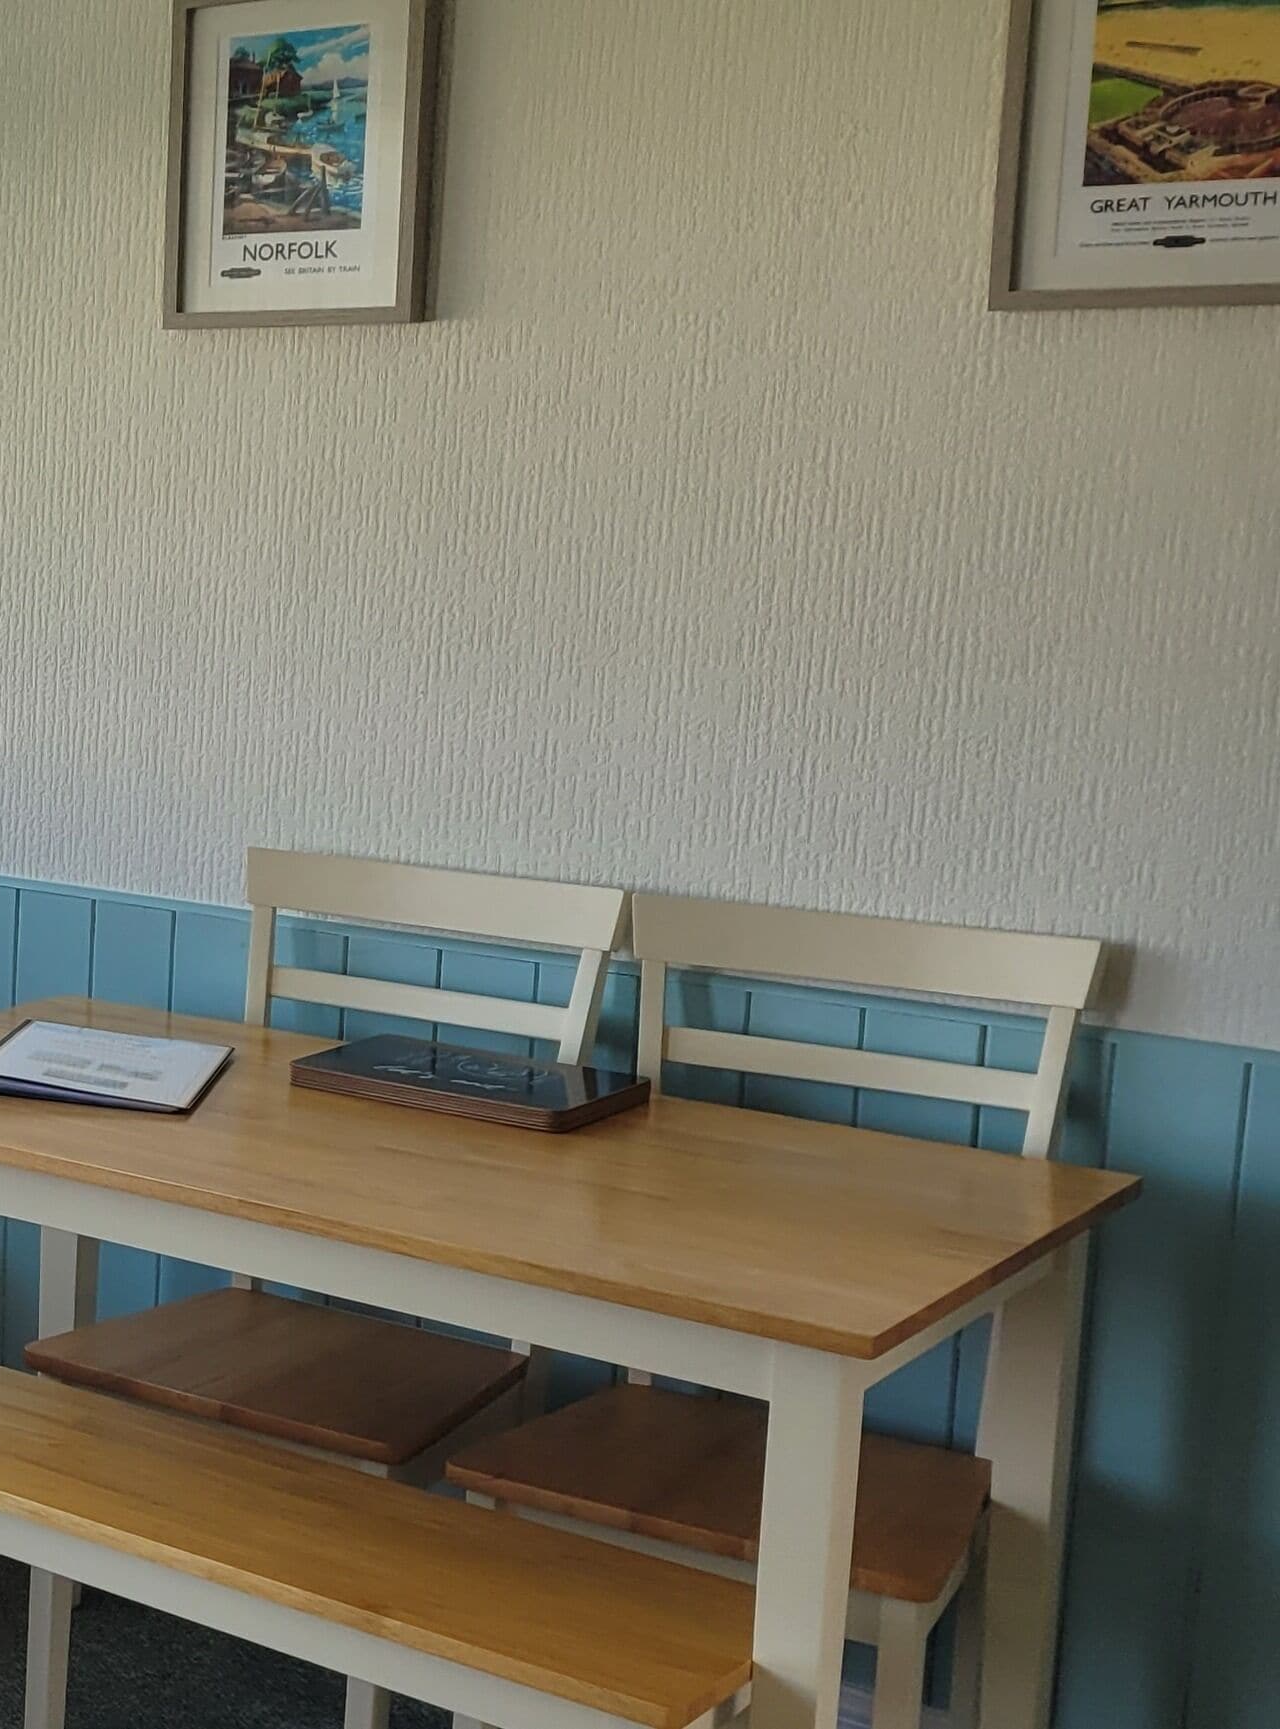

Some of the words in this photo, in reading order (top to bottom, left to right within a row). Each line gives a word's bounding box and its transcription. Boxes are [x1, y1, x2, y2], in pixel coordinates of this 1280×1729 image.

[1090, 196, 1152, 213] GREAT
[1164, 190, 1277, 211] YARMOUTH
[242, 240, 338, 262] NORFOLK
